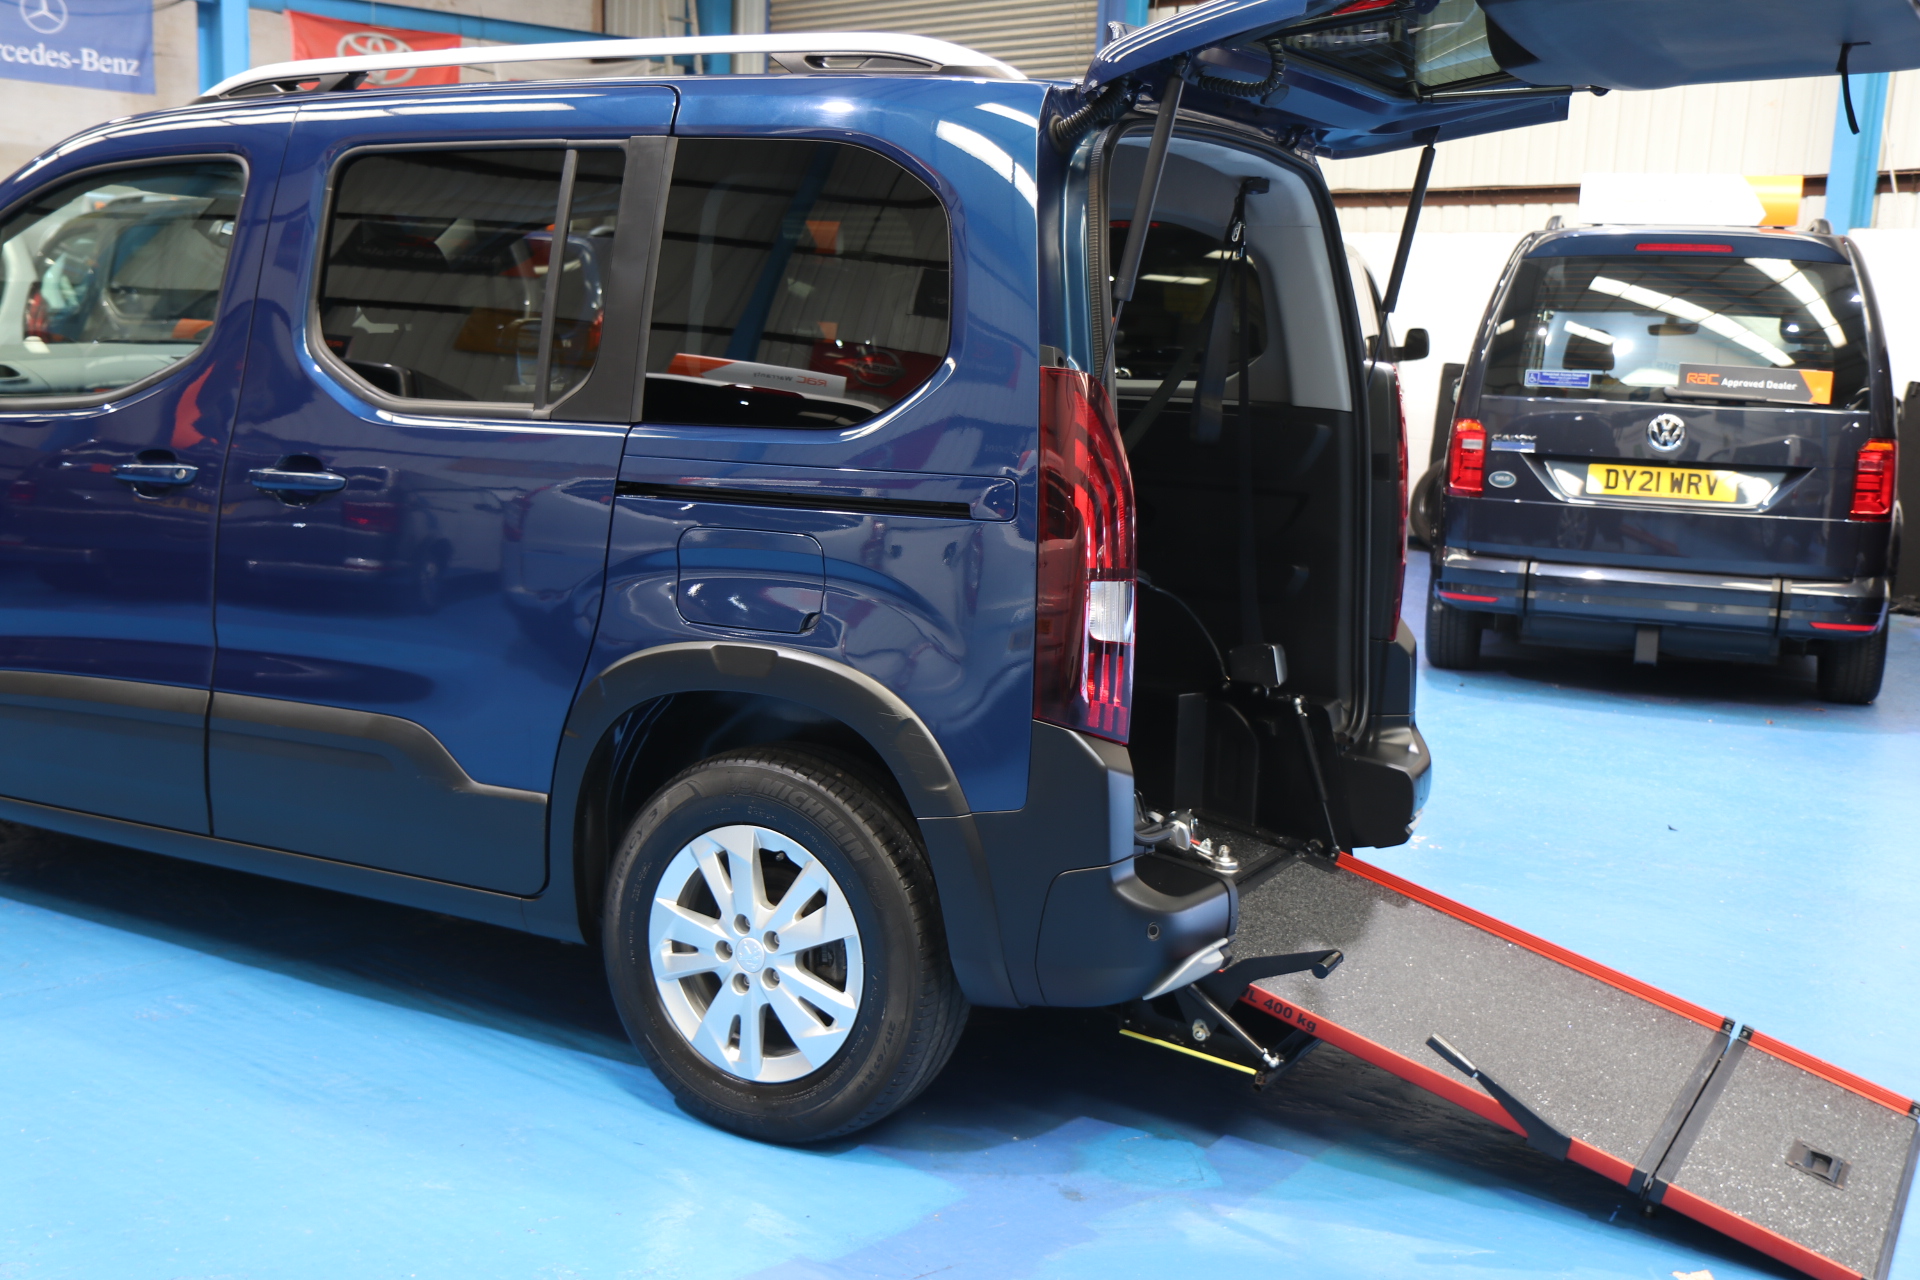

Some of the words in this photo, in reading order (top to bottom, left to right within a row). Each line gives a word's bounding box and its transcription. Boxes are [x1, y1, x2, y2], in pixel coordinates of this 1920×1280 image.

[0, 42, 141, 77] cedes-Benz
[1721, 377, 1764, 389] Approved
[1766, 380, 1798, 391] Dealer
[1604, 468, 1661, 493] DY21
[1670, 471, 1719, 496] WRV
[755, 777, 871, 862] MICHELIN
[1263, 999, 1293, 1019] 400
[1296, 1012, 1317, 1034] kg
